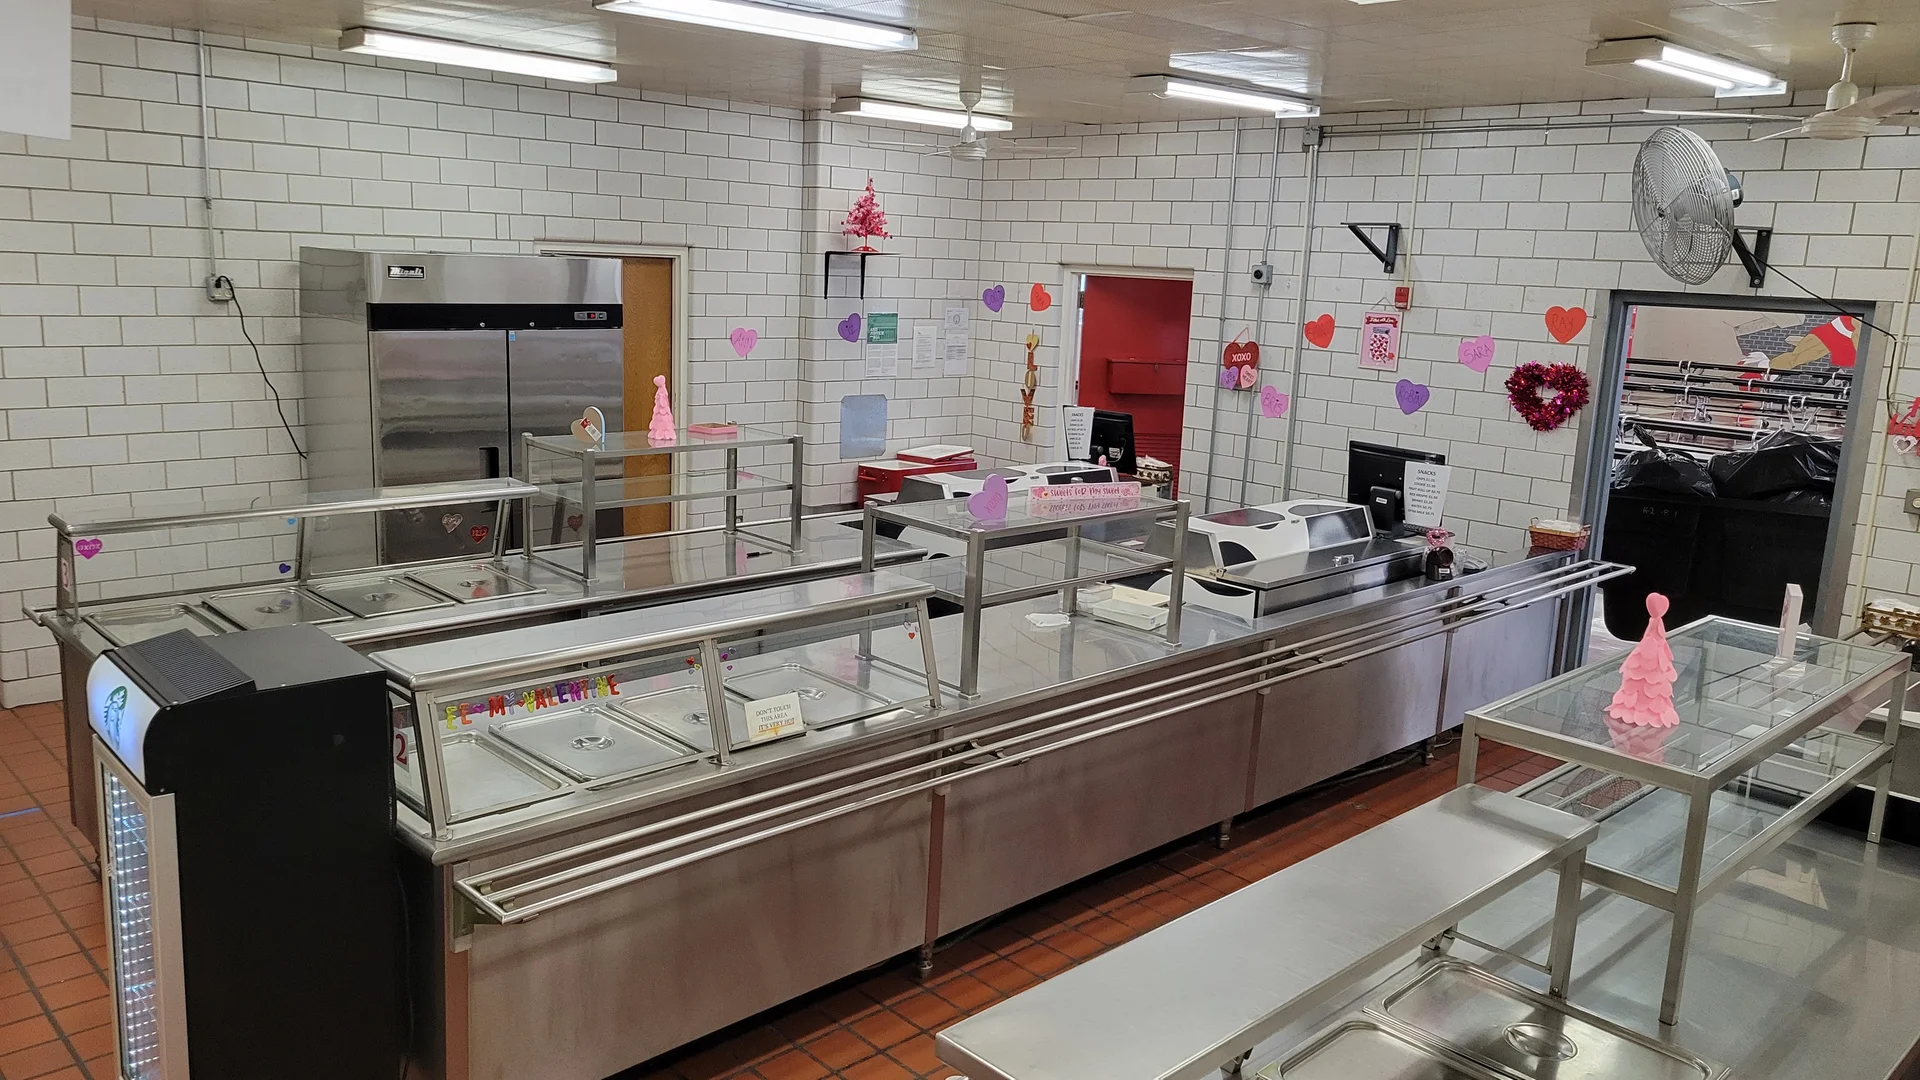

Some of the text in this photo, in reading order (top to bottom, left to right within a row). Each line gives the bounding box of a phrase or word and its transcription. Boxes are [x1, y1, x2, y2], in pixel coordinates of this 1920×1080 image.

[1231, 352, 1252, 363] XOXO
[1464, 344, 1492, 364] SARA
[1020, 351, 1038, 426] LOVE
[1417, 469, 1437, 477] SNACKS
[983, 491, 1003, 514] XOXO
[488, 692, 516, 717] MY
[521, 674, 620, 713] VALENTINE
[755, 703, 791, 717] DON'T TOUCH
[761, 712, 788, 723] THIS AREA
[769, 719, 783, 728] VERY
[783, 717, 794, 725] HOT
[395, 733, 407, 766] 2
